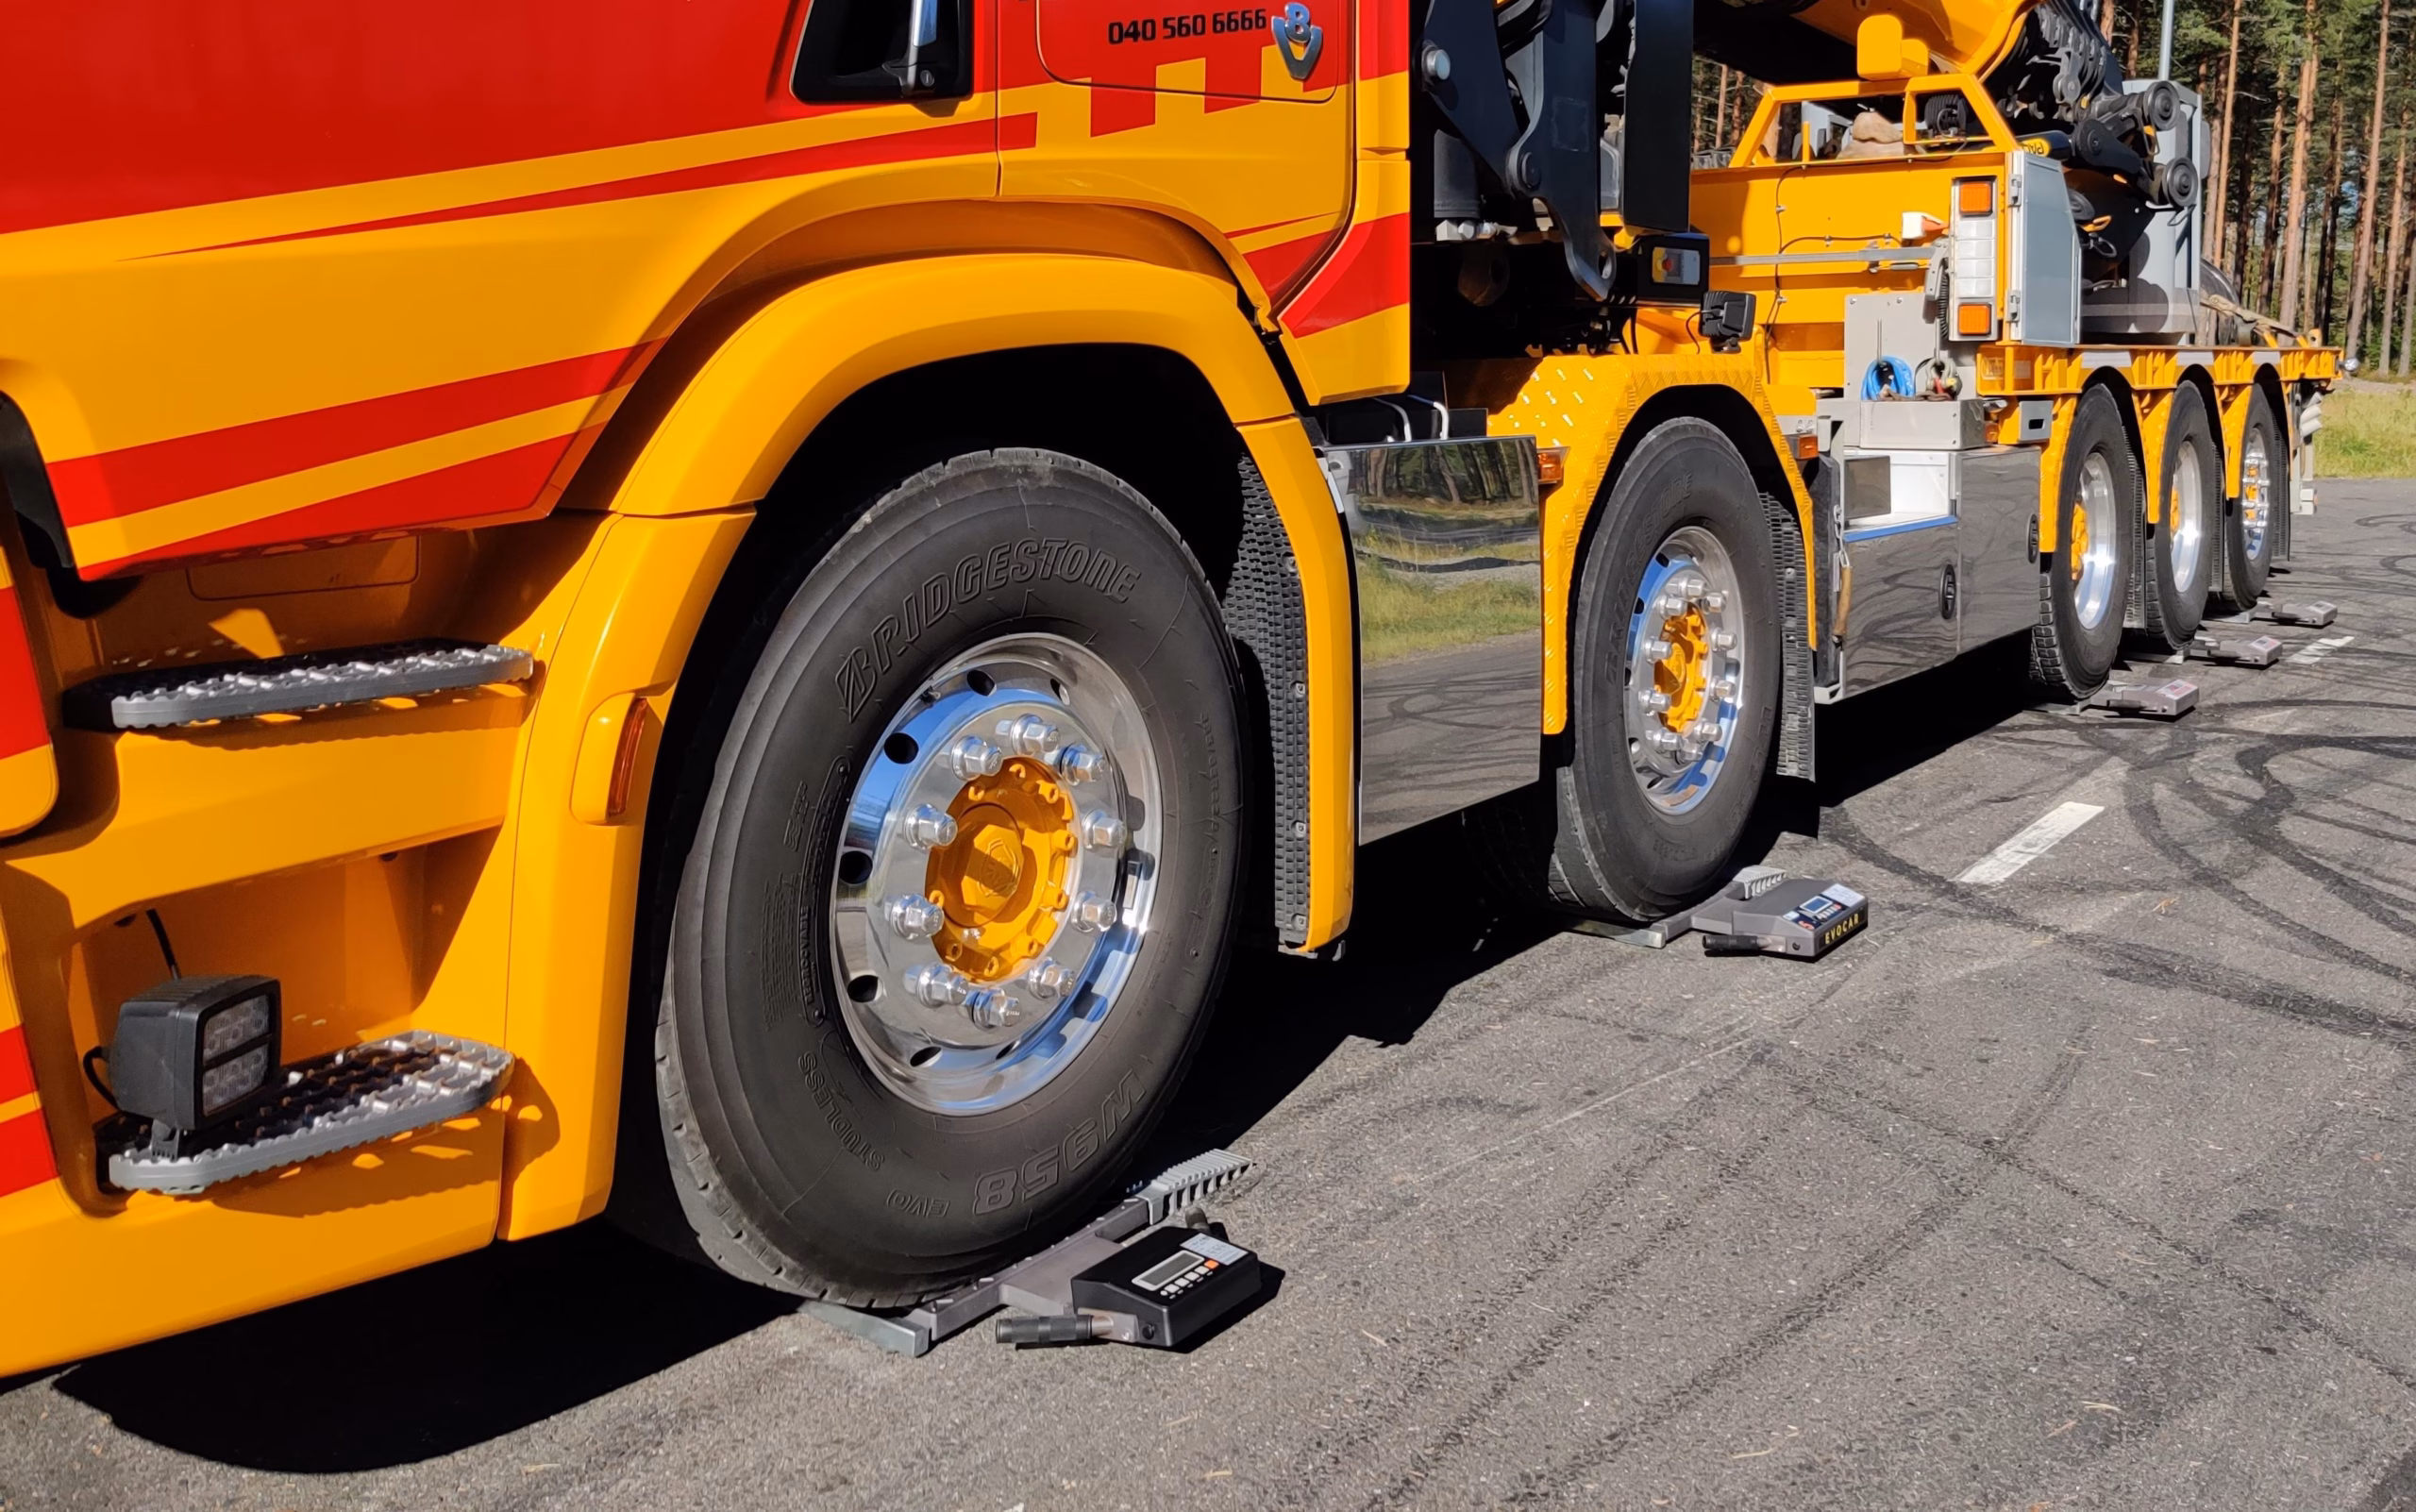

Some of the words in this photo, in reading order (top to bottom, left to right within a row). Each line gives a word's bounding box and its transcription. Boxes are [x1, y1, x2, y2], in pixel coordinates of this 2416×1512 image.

[1108, 19, 1156, 44] 040
[1162, 14, 1206, 40] 560
[1212, 8, 1267, 34] 6666
[834, 536, 1141, 724] BRIDGESTONE
[1824, 913, 1859, 945] EVOCAR
[797, 1051, 885, 1172] STUDLESS
[972, 1067, 1147, 1217] W958
[885, 1187, 951, 1218] EVO
